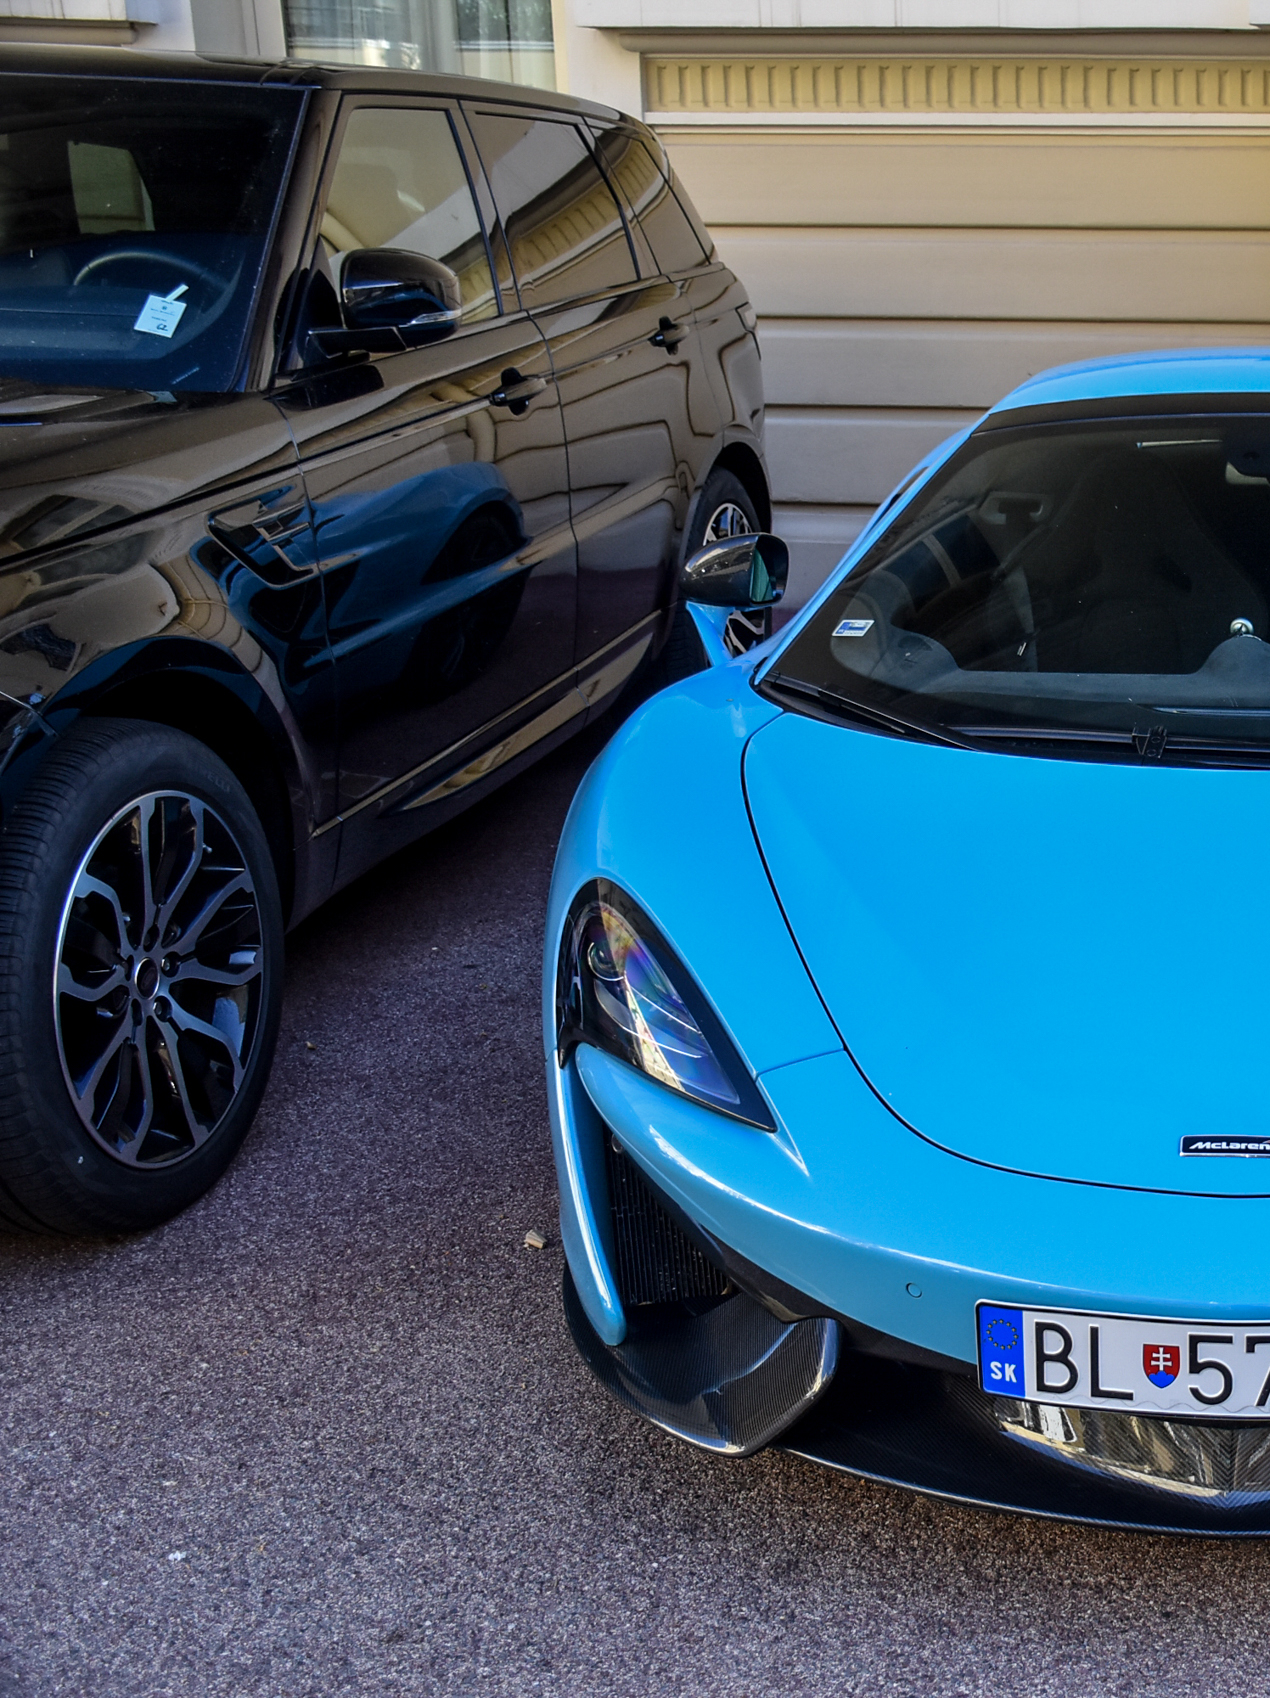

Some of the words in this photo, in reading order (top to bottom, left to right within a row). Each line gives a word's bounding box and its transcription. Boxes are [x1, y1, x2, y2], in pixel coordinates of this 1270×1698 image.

[1189, 1141, 1270, 1150] McLaren
[1035, 1319, 1135, 1401] BL
[990, 1361, 1017, 1384] SK
